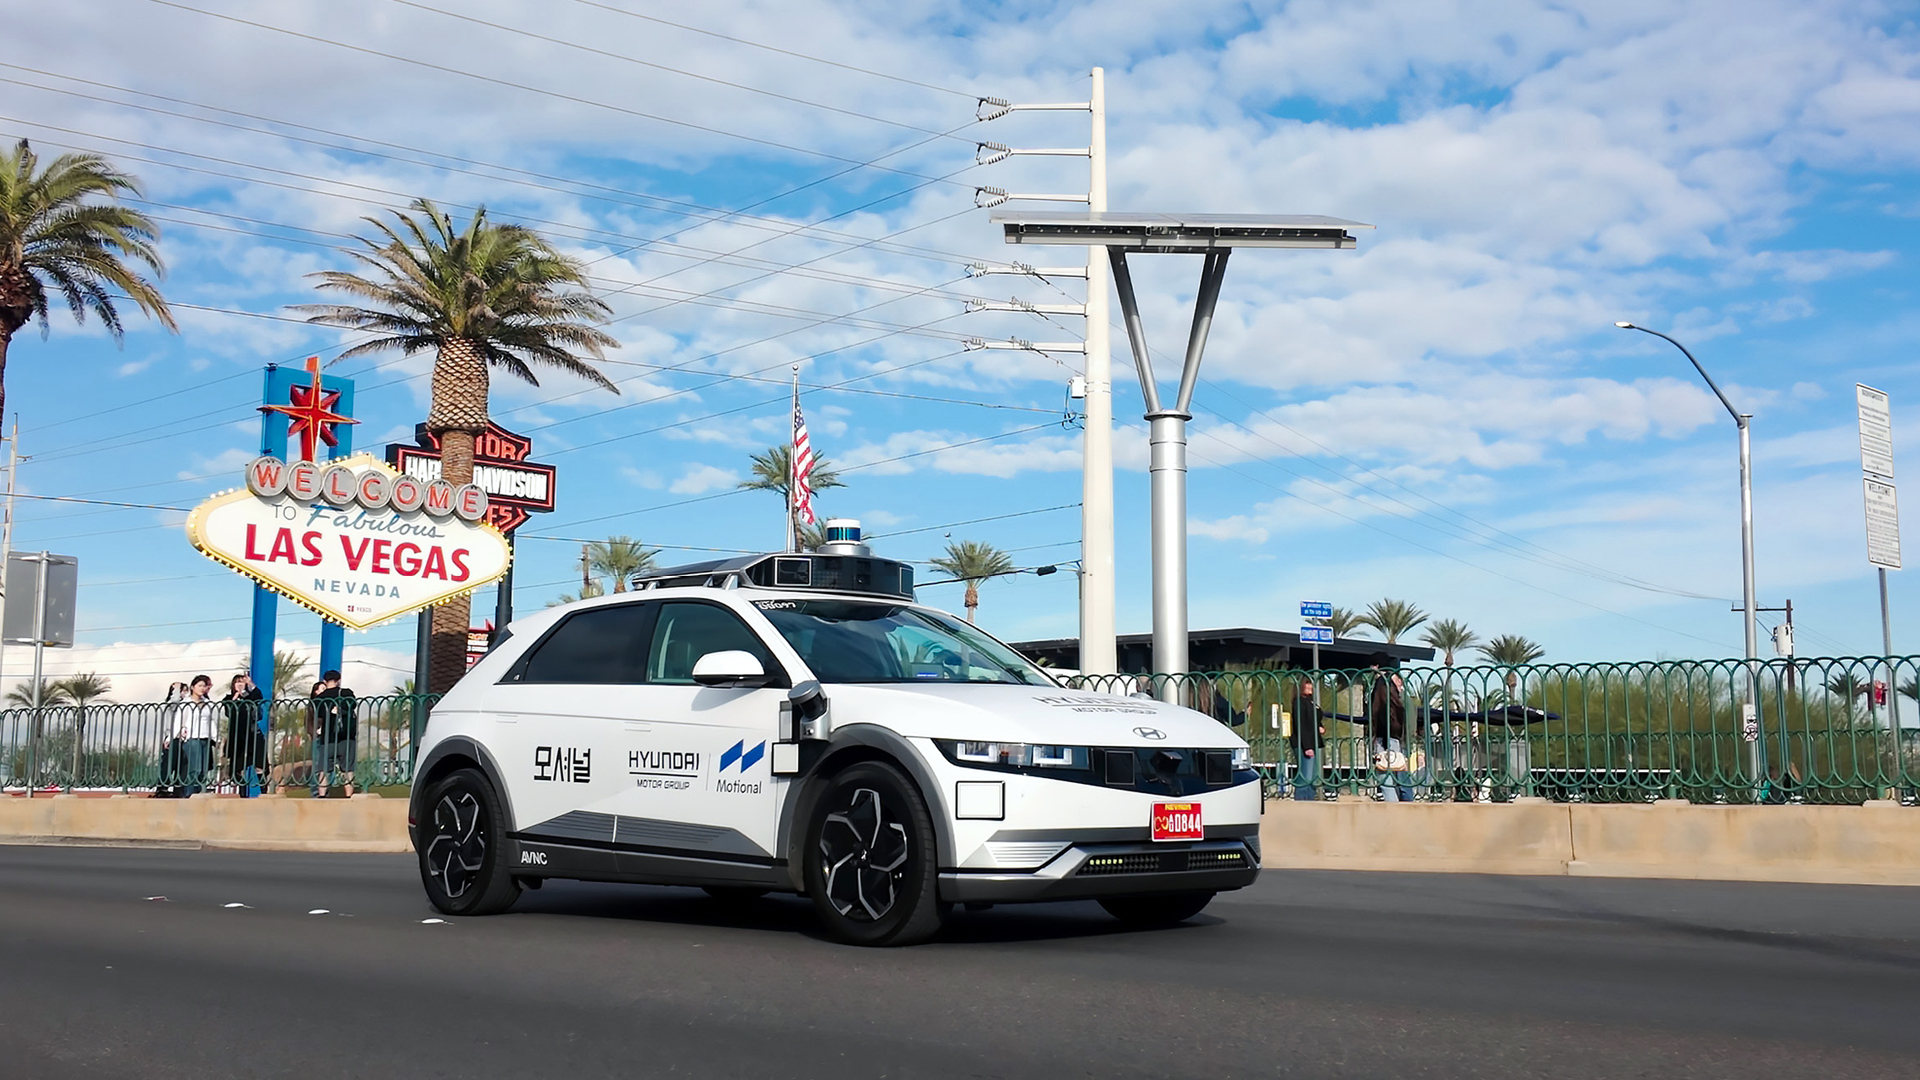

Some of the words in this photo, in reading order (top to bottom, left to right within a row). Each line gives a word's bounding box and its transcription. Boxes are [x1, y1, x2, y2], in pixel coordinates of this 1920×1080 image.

[256, 464, 478, 513] WELCOME
[272, 504, 297, 521] TO
[306, 504, 446, 538] Fabulous
[245, 523, 323, 567] LAS
[339, 534, 470, 582] VEGAS
[314, 578, 401, 599] NEVADA
[534, 746, 591, 783] 모셔널
[629, 751, 700, 770] HYUNDAI
[637, 779, 662, 789] MOTOR
[664, 780, 690, 790] GROUP
[716, 779, 762, 795] Motional
[521, 851, 548, 865] AVNC
